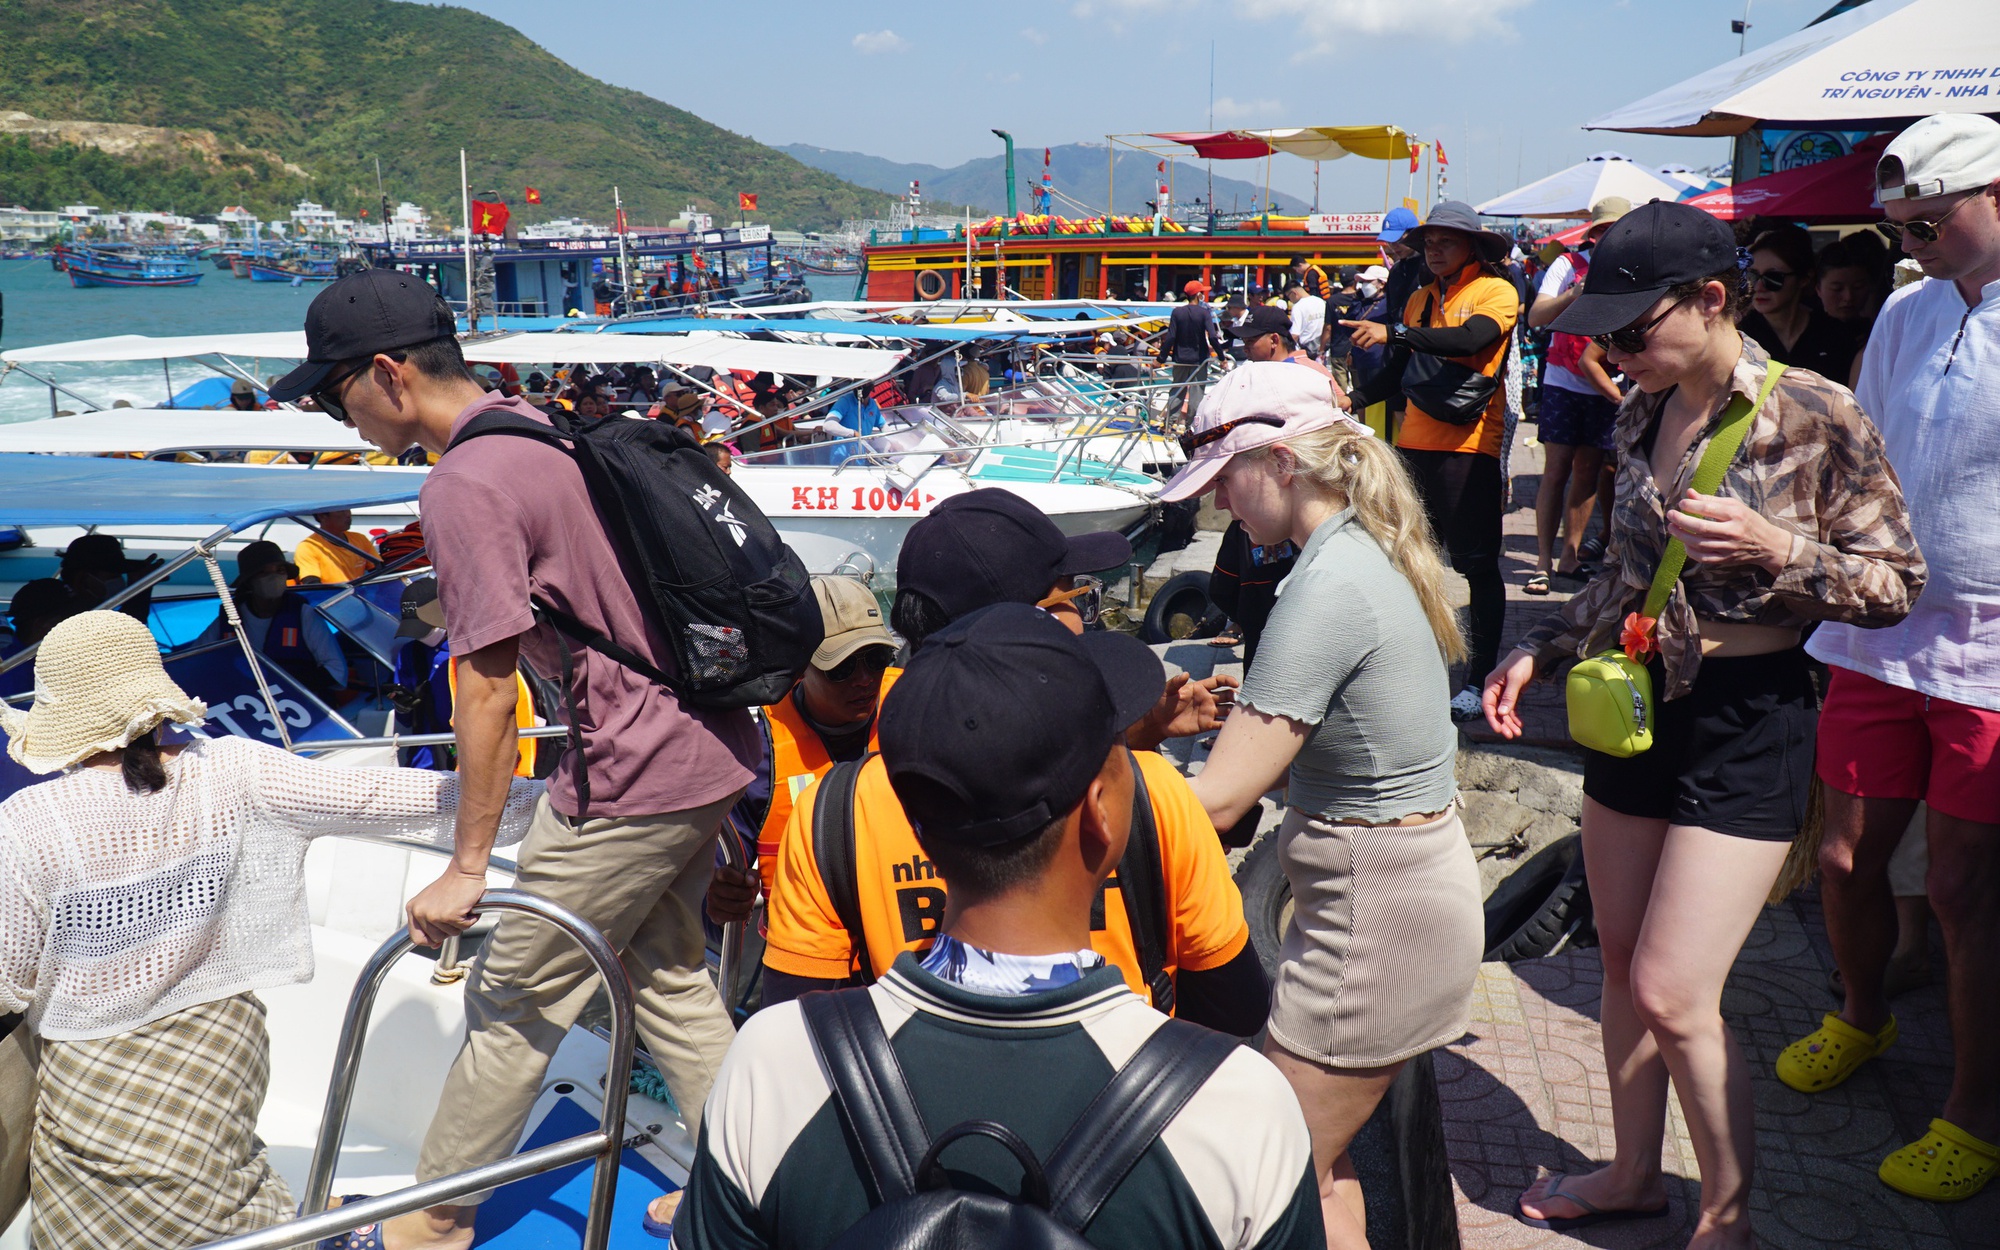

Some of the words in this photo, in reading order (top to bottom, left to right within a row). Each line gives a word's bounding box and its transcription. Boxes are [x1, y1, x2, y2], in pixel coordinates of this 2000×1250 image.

[1840, 69, 1900, 82] CÔNG
[1904, 70, 1929, 81] TY
[1931, 67, 1988, 80] TNHH
[1821, 85, 1855, 99] TRÍ
[1851, 84, 1932, 99] NGUYÊN
[1945, 84, 1989, 98] NHA
[1326, 223, 1372, 231] TT-48K
[791, 486, 840, 510] KH
[850, 486, 921, 511] 1004
